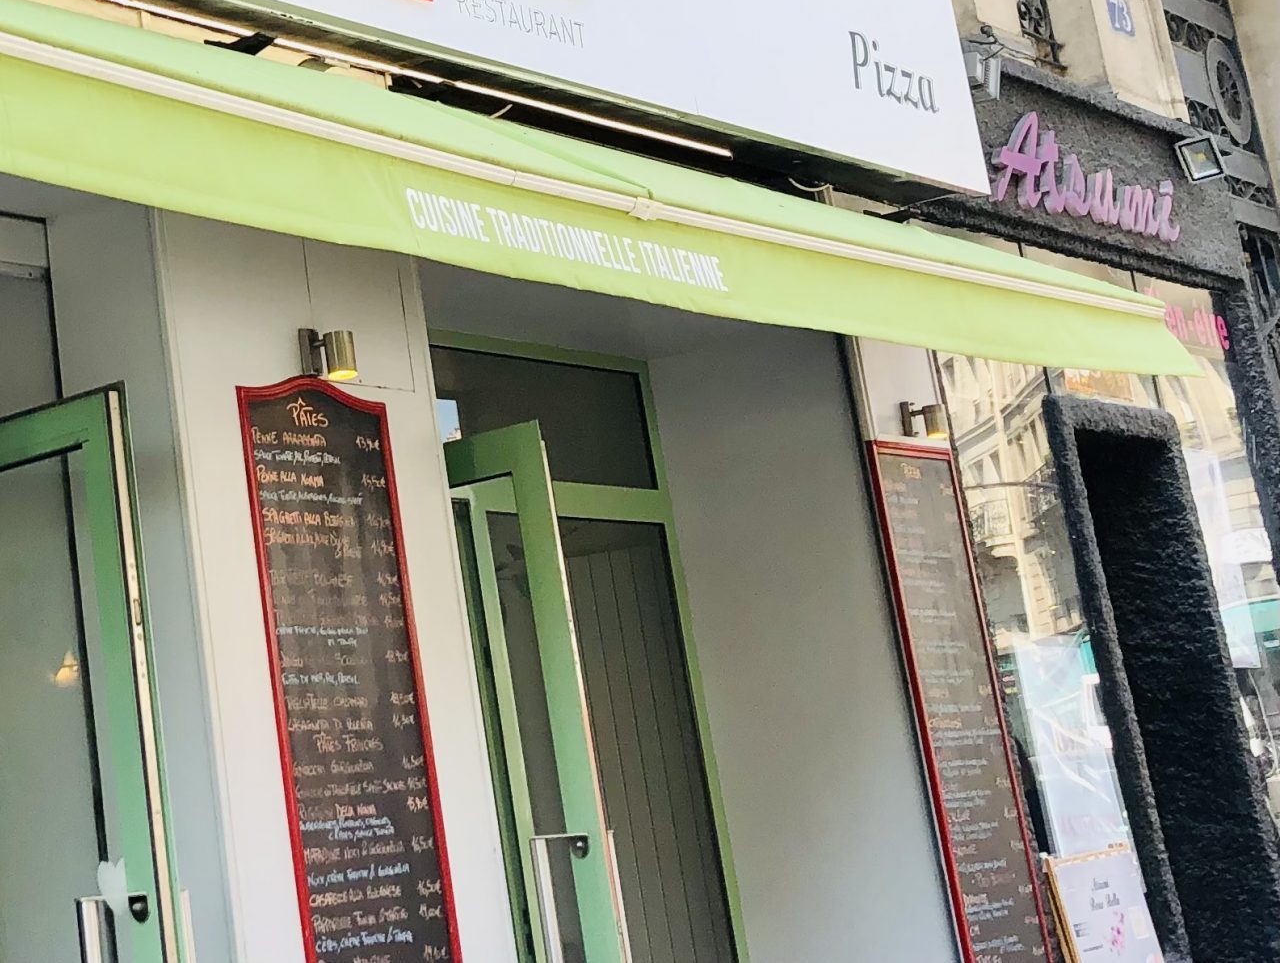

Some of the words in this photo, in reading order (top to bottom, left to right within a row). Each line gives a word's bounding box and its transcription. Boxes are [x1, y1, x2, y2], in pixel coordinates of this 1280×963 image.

[848, 30, 940, 115] Pizza
[406, 187, 491, 244] CUISINE
[485, 206, 642, 274] TRADITIONNELLE
[637, 240, 729, 293] ITALIENNE
